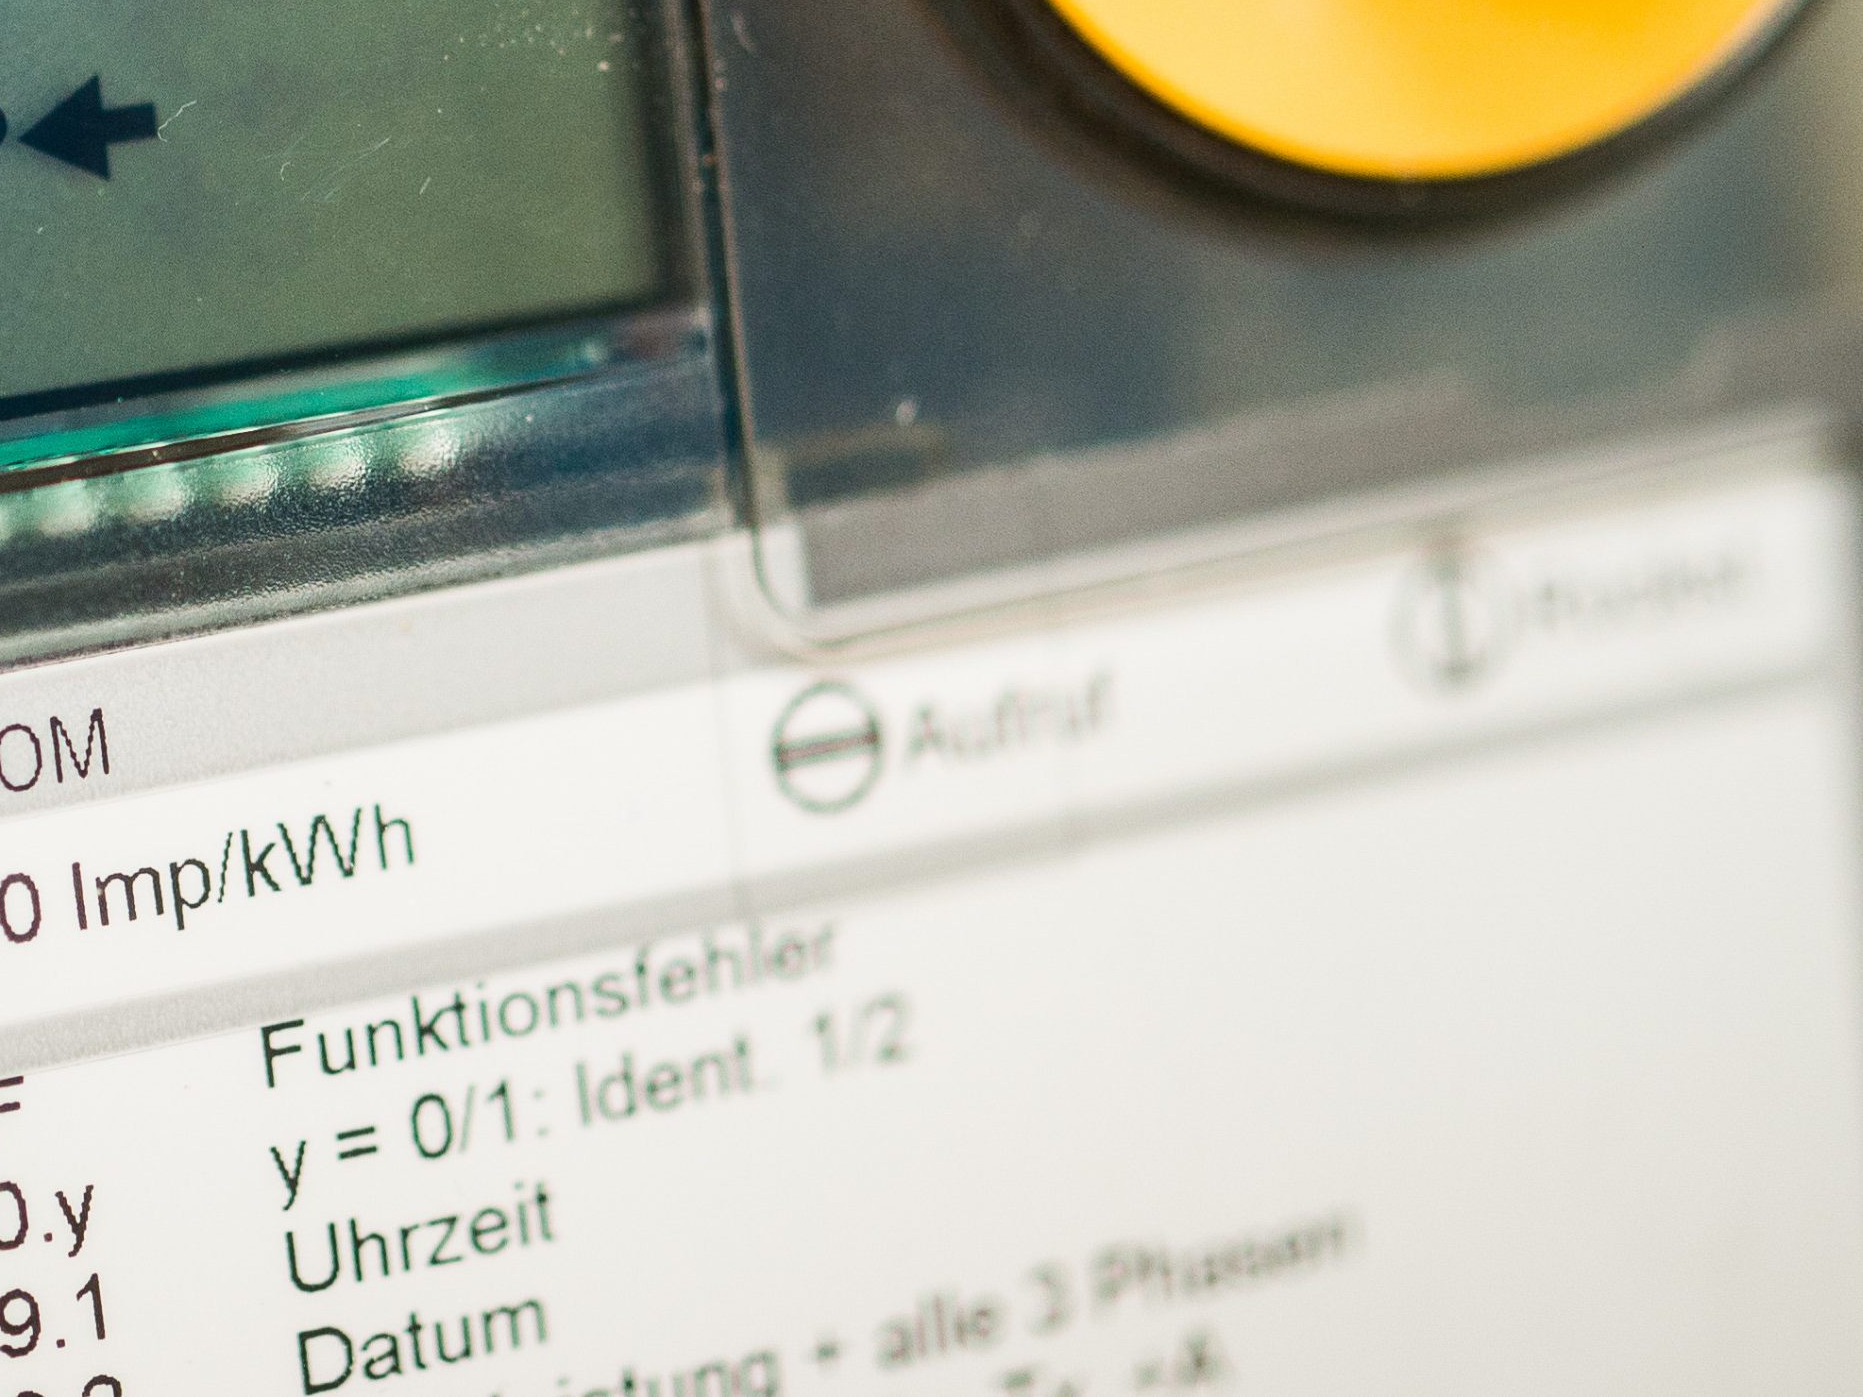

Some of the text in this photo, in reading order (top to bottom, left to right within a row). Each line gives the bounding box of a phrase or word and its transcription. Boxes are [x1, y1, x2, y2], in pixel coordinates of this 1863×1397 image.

[72, 803, 417, 932] Imp/kWh
[261, 918, 838, 1088] Funktionsfehler
[270, 1138, 308, 1210] y
[411, 1078, 550, 1160] 0/1:
[575, 1034, 781, 1128] Ident.
[810, 992, 916, 1072] 1/2
[284, 1180, 556, 1294] Uhrzeit
[297, 1297, 549, 1396] Datum
